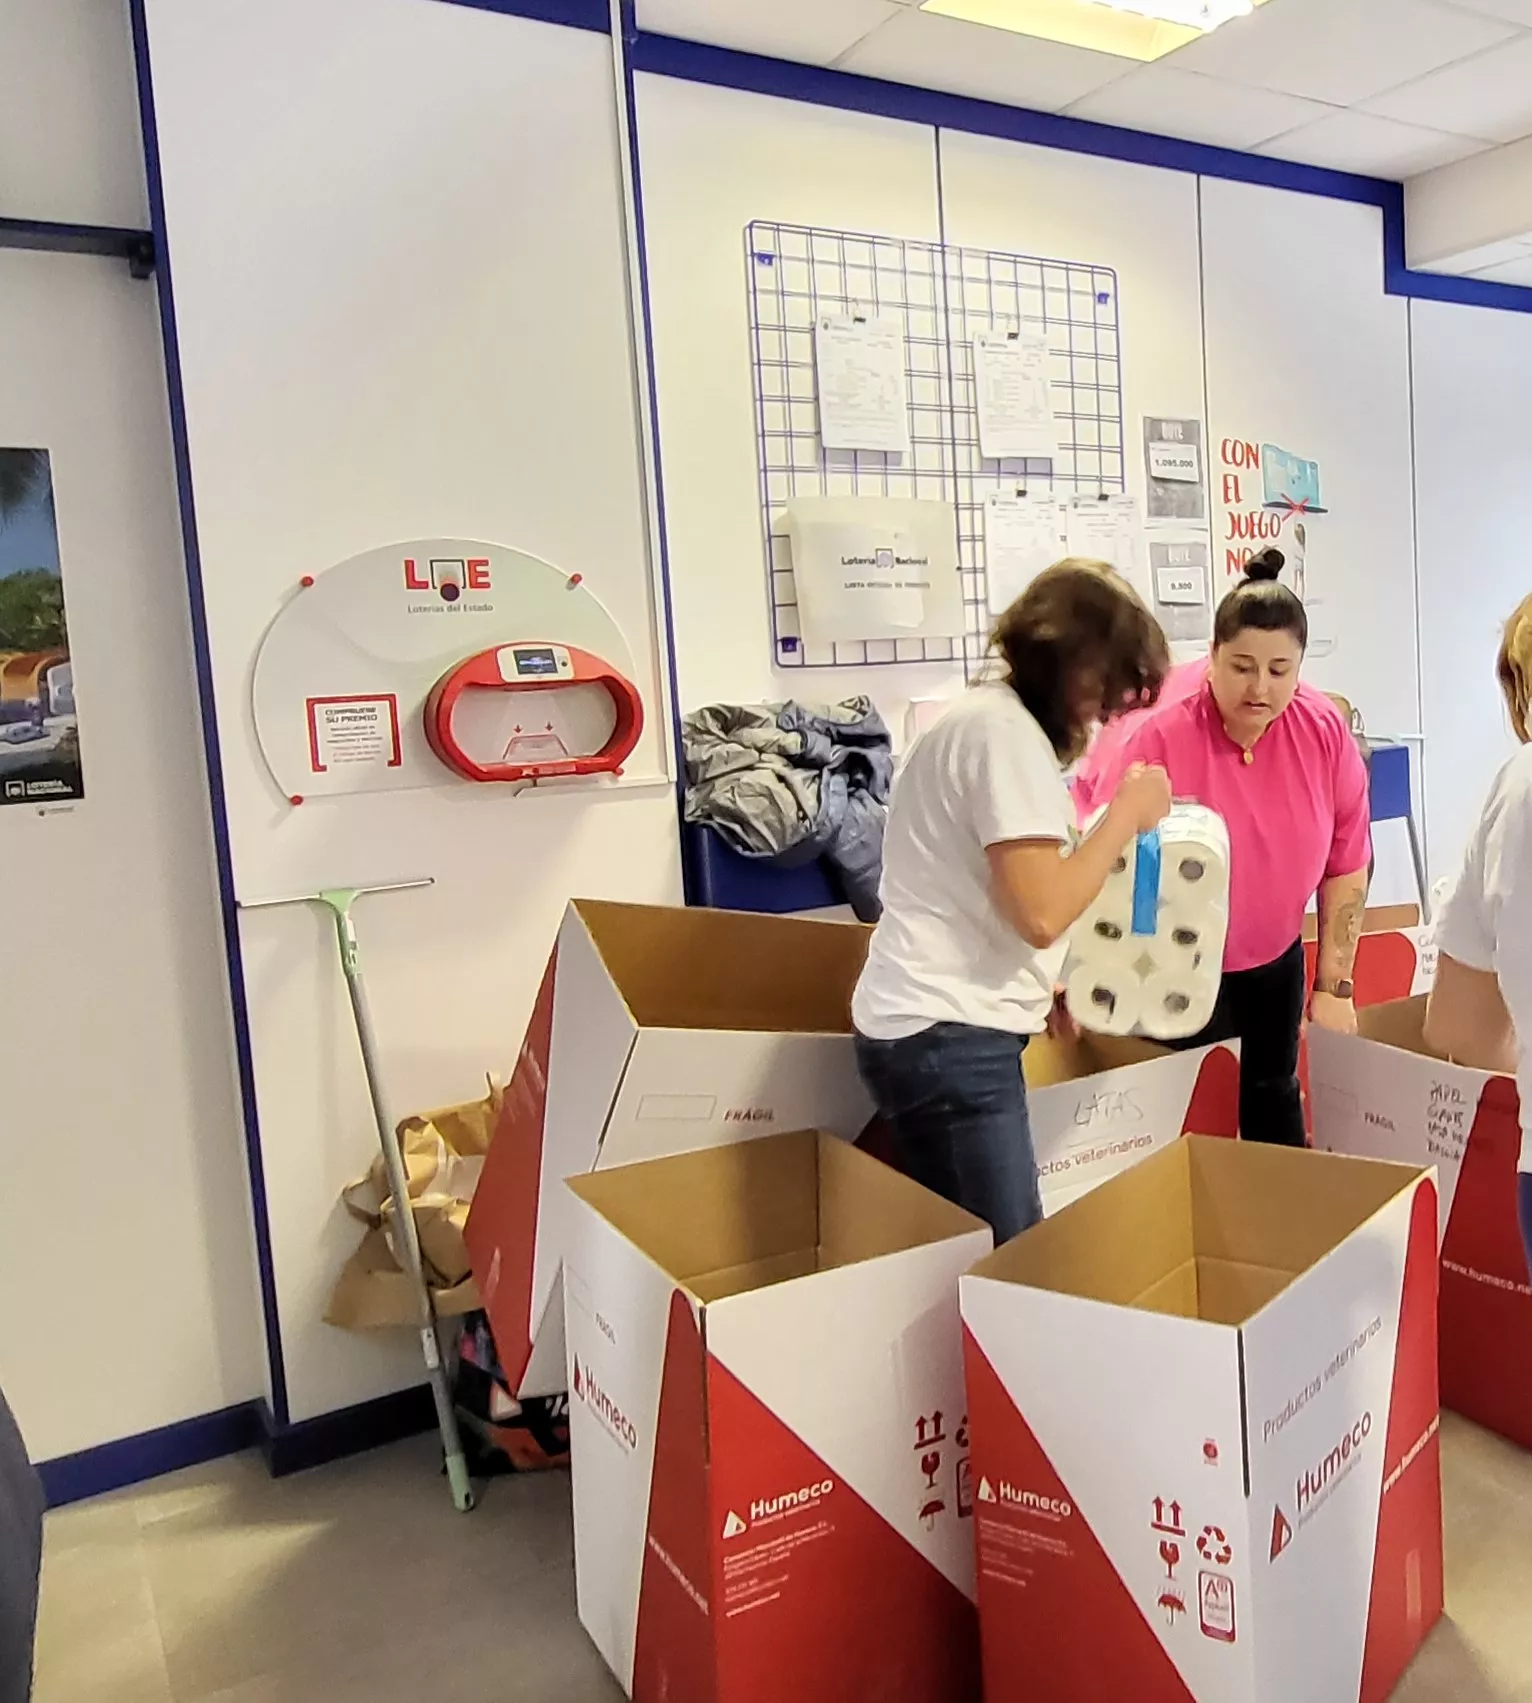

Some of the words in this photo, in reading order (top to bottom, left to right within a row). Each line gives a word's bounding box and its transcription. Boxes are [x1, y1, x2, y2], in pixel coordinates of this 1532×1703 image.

[1221, 438, 1260, 469] CON
[1223, 474, 1243, 504] EL
[1225, 511, 1281, 540] JUEGO
[341, 714, 378, 723] PREMIO
[1074, 1133, 1154, 1166] veterinarios
[1264, 1376, 1322, 1443] Productos
[1323, 1316, 1382, 1381] veterinarios
[586, 1365, 637, 1449] Humeco
[1297, 1411, 1372, 1511] Humeco
[751, 1479, 834, 1520] Humeco
[1000, 1480, 1071, 1517] Humeco
